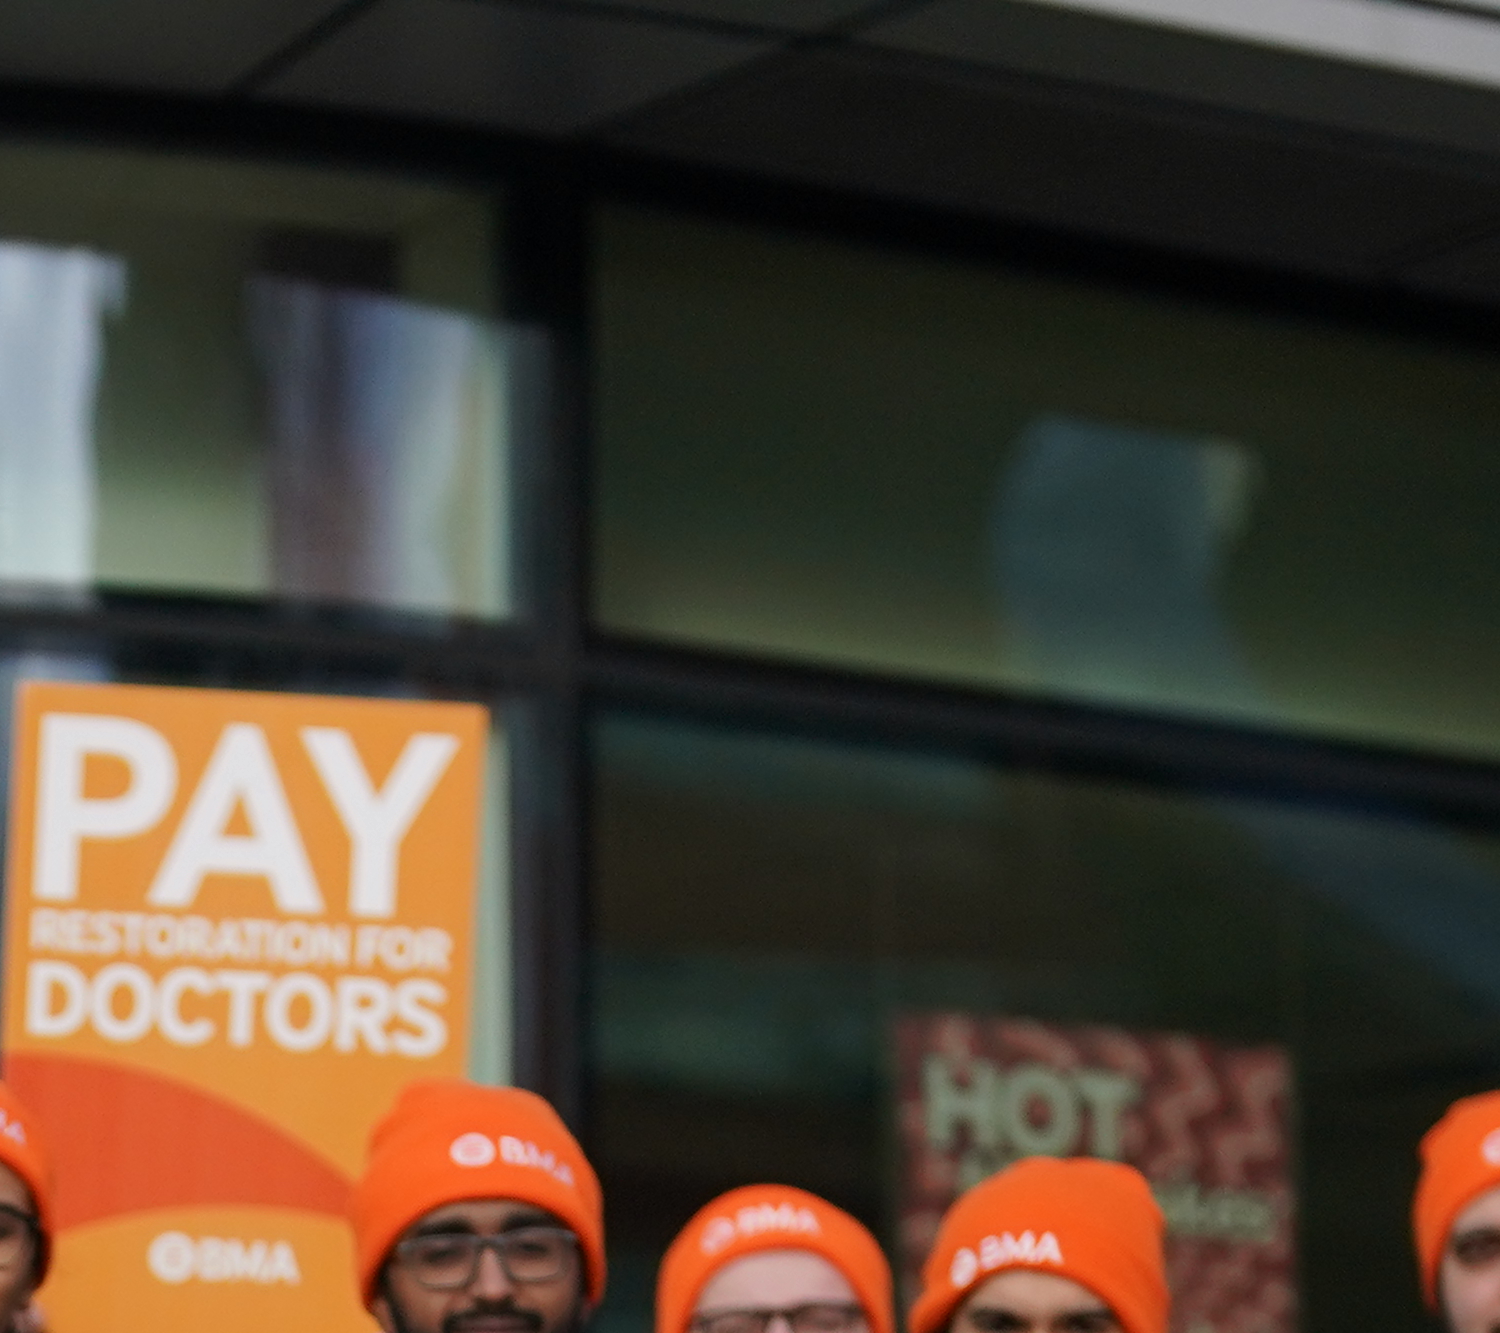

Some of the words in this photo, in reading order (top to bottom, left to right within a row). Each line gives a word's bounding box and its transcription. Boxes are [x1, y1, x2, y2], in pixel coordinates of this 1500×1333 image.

[32, 712, 461, 918] PAY
[30, 907, 348, 968] RESTORATION
[357, 923, 451, 971] FOR
[24, 960, 448, 1059] DOCTORS
[923, 1053, 1139, 1158] HOT
[199, 1234, 301, 1285] BMA
[980, 1230, 1063, 1270] BMA
